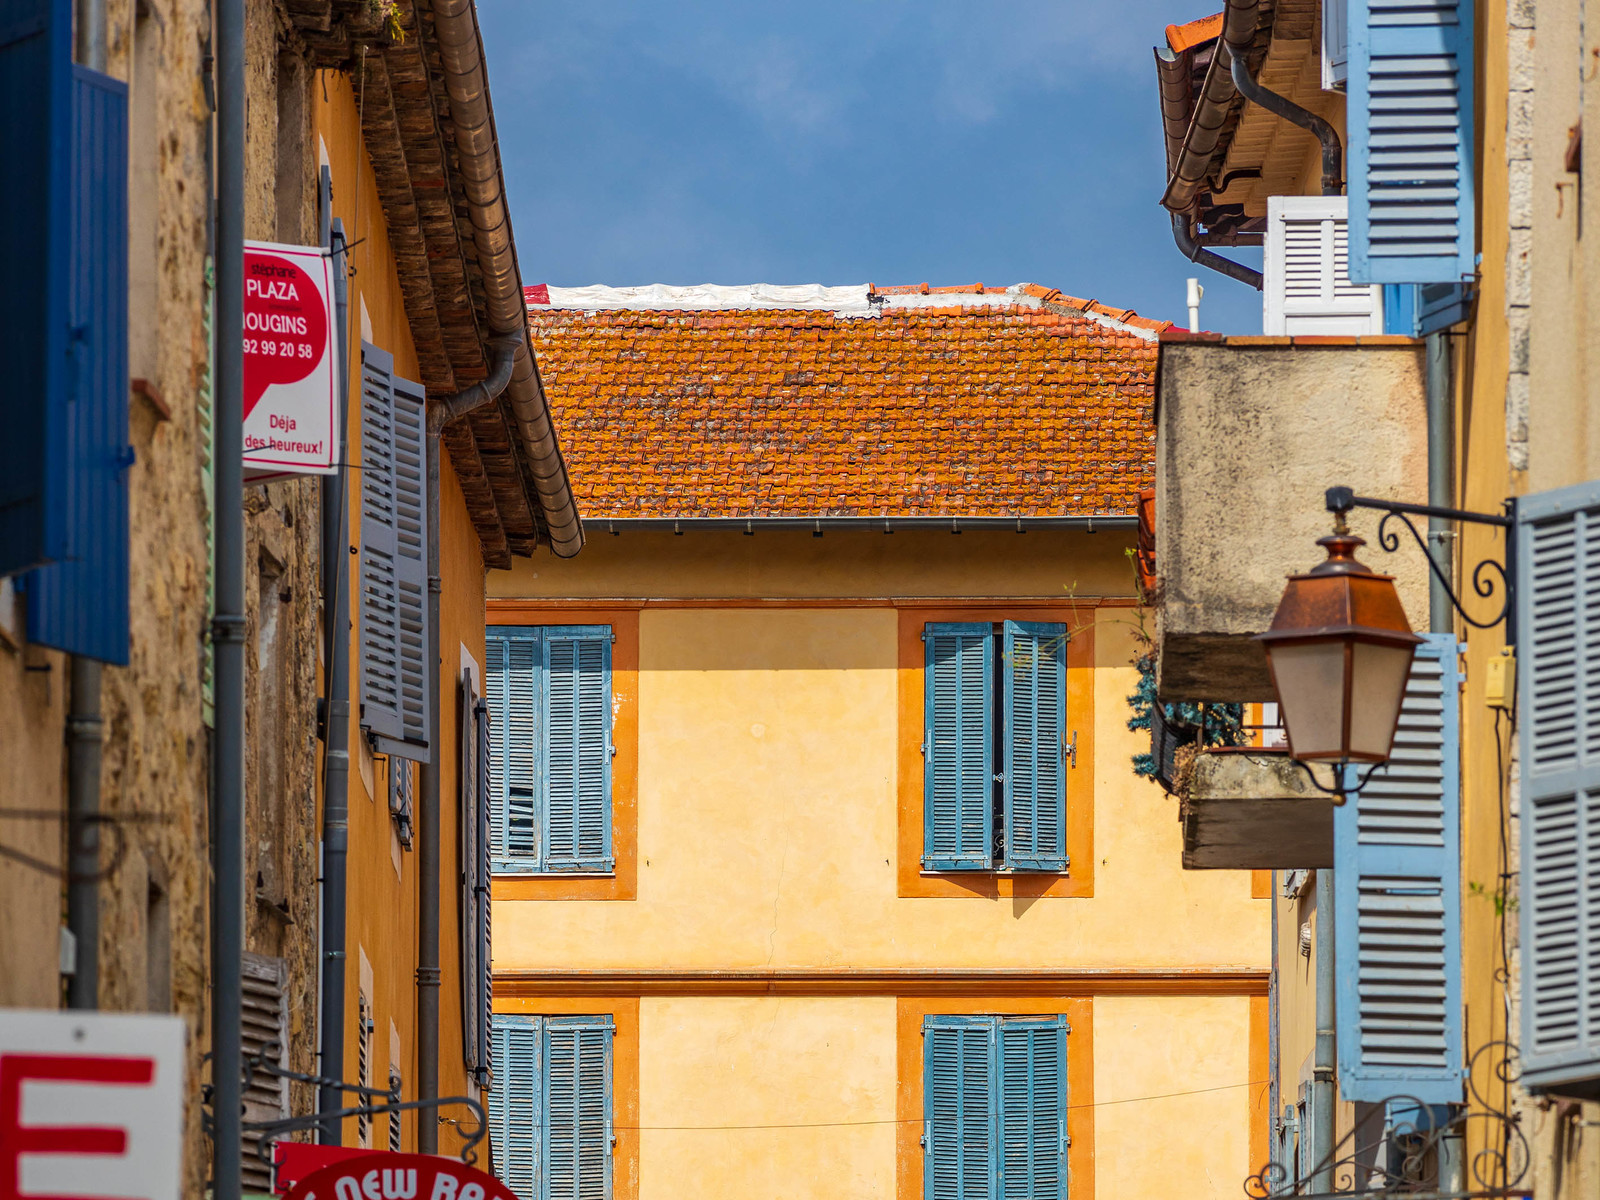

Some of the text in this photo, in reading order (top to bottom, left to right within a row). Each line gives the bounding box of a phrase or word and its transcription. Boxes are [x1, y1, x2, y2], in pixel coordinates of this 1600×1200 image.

[246, 278, 299, 301] PLAZA
[243, 311, 307, 335] OUGINS
[243, 338, 313, 359] 92 99 20 58
[269, 413, 296, 433] Déja
[244, 434, 323, 455] des heureux!
